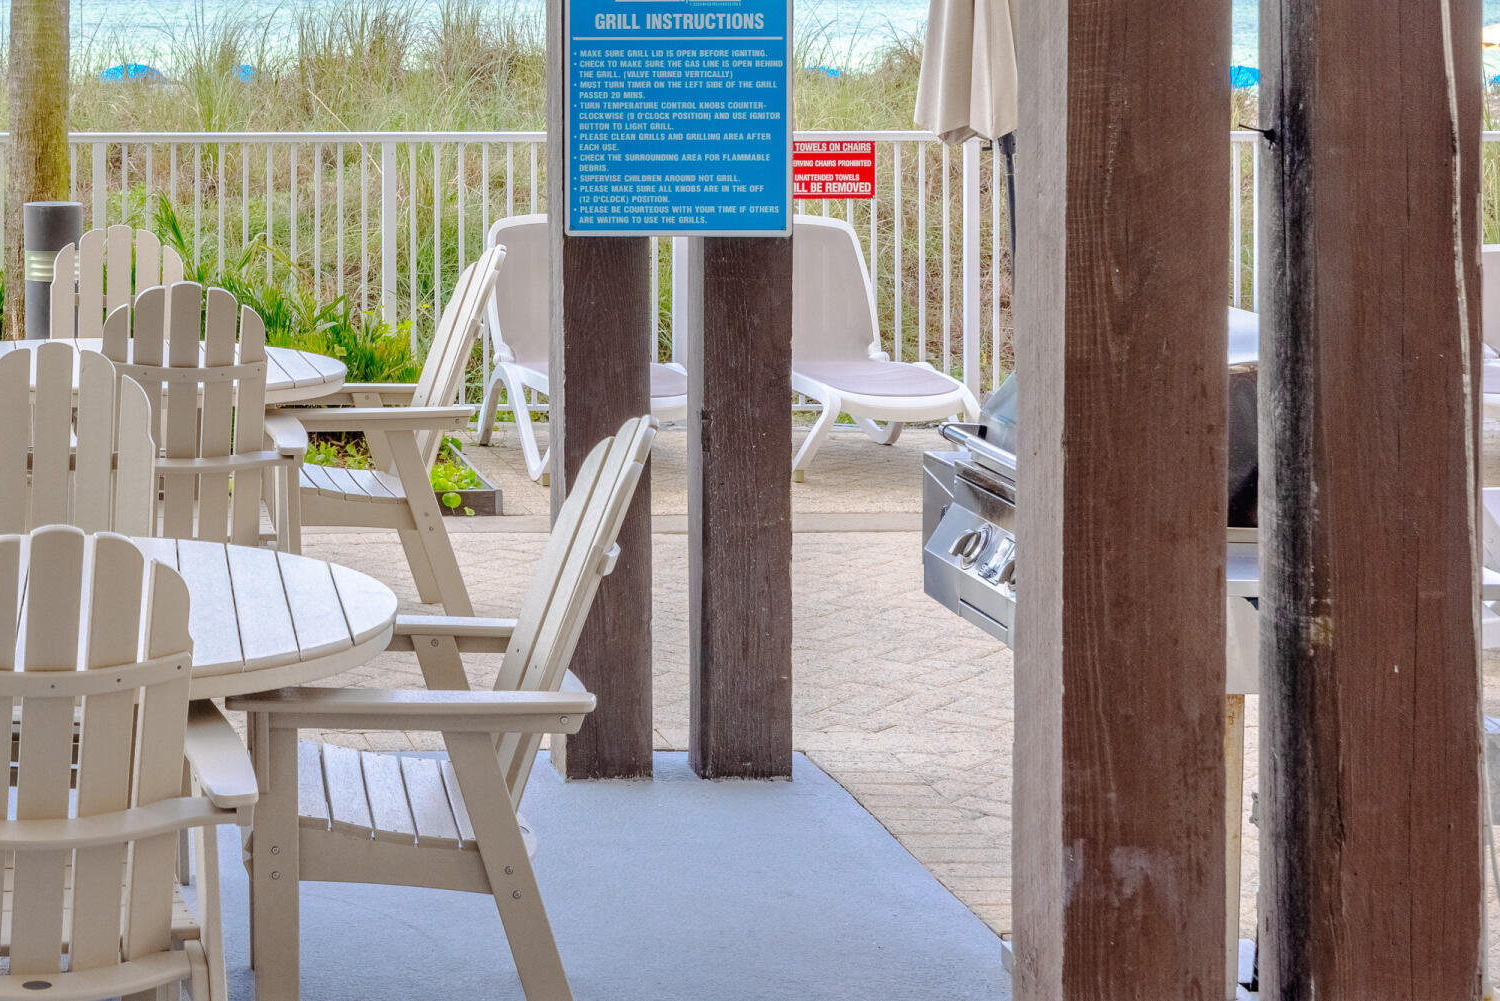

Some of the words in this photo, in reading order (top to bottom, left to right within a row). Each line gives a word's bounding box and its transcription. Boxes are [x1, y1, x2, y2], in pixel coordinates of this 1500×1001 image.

[595, 13, 640, 30] GRILL
[646, 13, 764, 30] INSTRUCTIONS
[580, 49, 602, 57] MAKE
[605, 49, 624, 57] SURE
[627, 49, 648, 57] GRILL
[651, 49, 664, 57] LID
[666, 49, 674, 57] IS
[676, 49, 696, 57] OPEN
[699, 49, 729, 57] BEFORE
[732, 49, 768, 57] IGNITING.
[580, 60, 605, 68] CHECK
[607, 60, 618, 68] TO
[620, 60, 642, 68] MAKE
[644, 60, 665, 68] SURE
[667, 60, 682, 68] THE
[684, 60, 700, 68] GAS
[702, 60, 719, 68] LINE
[722, 60, 730, 68] IS
[732, 60, 753, 68] OPEN
[755, 60, 783, 68] BEHIND
[579, 70, 593, 78] THE
[596, 70, 620, 78] GRILL.
[624, 70, 649, 80] (VALVE
[652, 70, 682, 78] TURNED
[684, 70, 733, 80] VERTICALLY)
[579, 91, 609, 99] PASSED
[611, 91, 621, 99] 20
[623, 91, 645, 99] MINS.
[579, 112, 624, 120] CLOCKWISE
[637, 112, 670, 120] O'CLOCK
[672, 112, 711, 121] POSITION)
[714, 112, 730, 120] AND
[732, 112, 747, 120] USE
[750, 112, 780, 120] IGNITOR
[579, 122, 610, 130] BUTTON
[612, 122, 622, 130] TO
[624, 122, 647, 130] LIGHT
[650, 122, 674, 130] GRILL.
[580, 133, 608, 141] PLEASE
[611, 133, 636, 141] CLEAN
[638, 133, 665, 141] GRILLS
[668, 133, 684, 141] AND
[686, 133, 721, 141] GRILLING
[723, 133, 744, 141] AREA
[746, 133, 771, 141] AFTER
[579, 143, 600, 151] EACH
[602, 143, 620, 151] USE.
[795, 143, 827, 152] TOWELS
[829, 143, 840, 152] ON
[842, 143, 871, 152] CHAIRS
[580, 153, 605, 161] CHECK
[608, 153, 622, 161] THE
[625, 153, 679, 161] SURROUNDING
[681, 153, 702, 161] AREA
[704, 153, 720, 161] FOR
[722, 153, 770, 161] FLAMMABLE
[815, 159, 836, 167] CHAIRS
[837, 159, 872, 167] PROHIBITED
[579, 164, 609, 172] DEBRIS.
[580, 174, 622, 182] SUPERVISE
[624, 174, 662, 182] CHILDREN
[664, 174, 696, 182] AROUND
[698, 174, 714, 182] HOT
[716, 174, 740, 182] GRILL.
[794, 173, 834, 181] UNATTENDED
[835, 173, 860, 181] TOWELS
[580, 185, 608, 193] PLEASE
[611, 185, 633, 193] MAKE
[636, 185, 656, 193] SURE
[658, 185, 672, 193] ALL
[675, 185, 701, 193] KNOBS
[704, 185, 718, 193] ARE
[721, 185, 730, 193] IN
[732, 185, 746, 193] THE
[749, 185, 764, 193] OFF
[810, 182, 823, 193] BE
[825, 182, 872, 193] REMOVED
[579, 195, 590, 205] (12
[592, 195, 629, 205] O'CLOCK)
[631, 195, 670, 204] POSITION.
[580, 205, 608, 214] PLEASE
[611, 205, 621, 214] BE
[624, 205, 669, 214] COURTEOUS
[672, 205, 692, 214] WITH
[694, 205, 715, 214] YOUR
[718, 205, 736, 214] TIME
[739, 205, 746, 214] IF
[749, 205, 779, 214] OTHERS
[579, 216, 594, 224] ARE
[596, 216, 629, 224] WAITING
[632, 216, 642, 224] TO
[644, 216, 658, 224] USE
[661, 216, 675, 224] THE
[678, 216, 707, 224] GRILLS.
